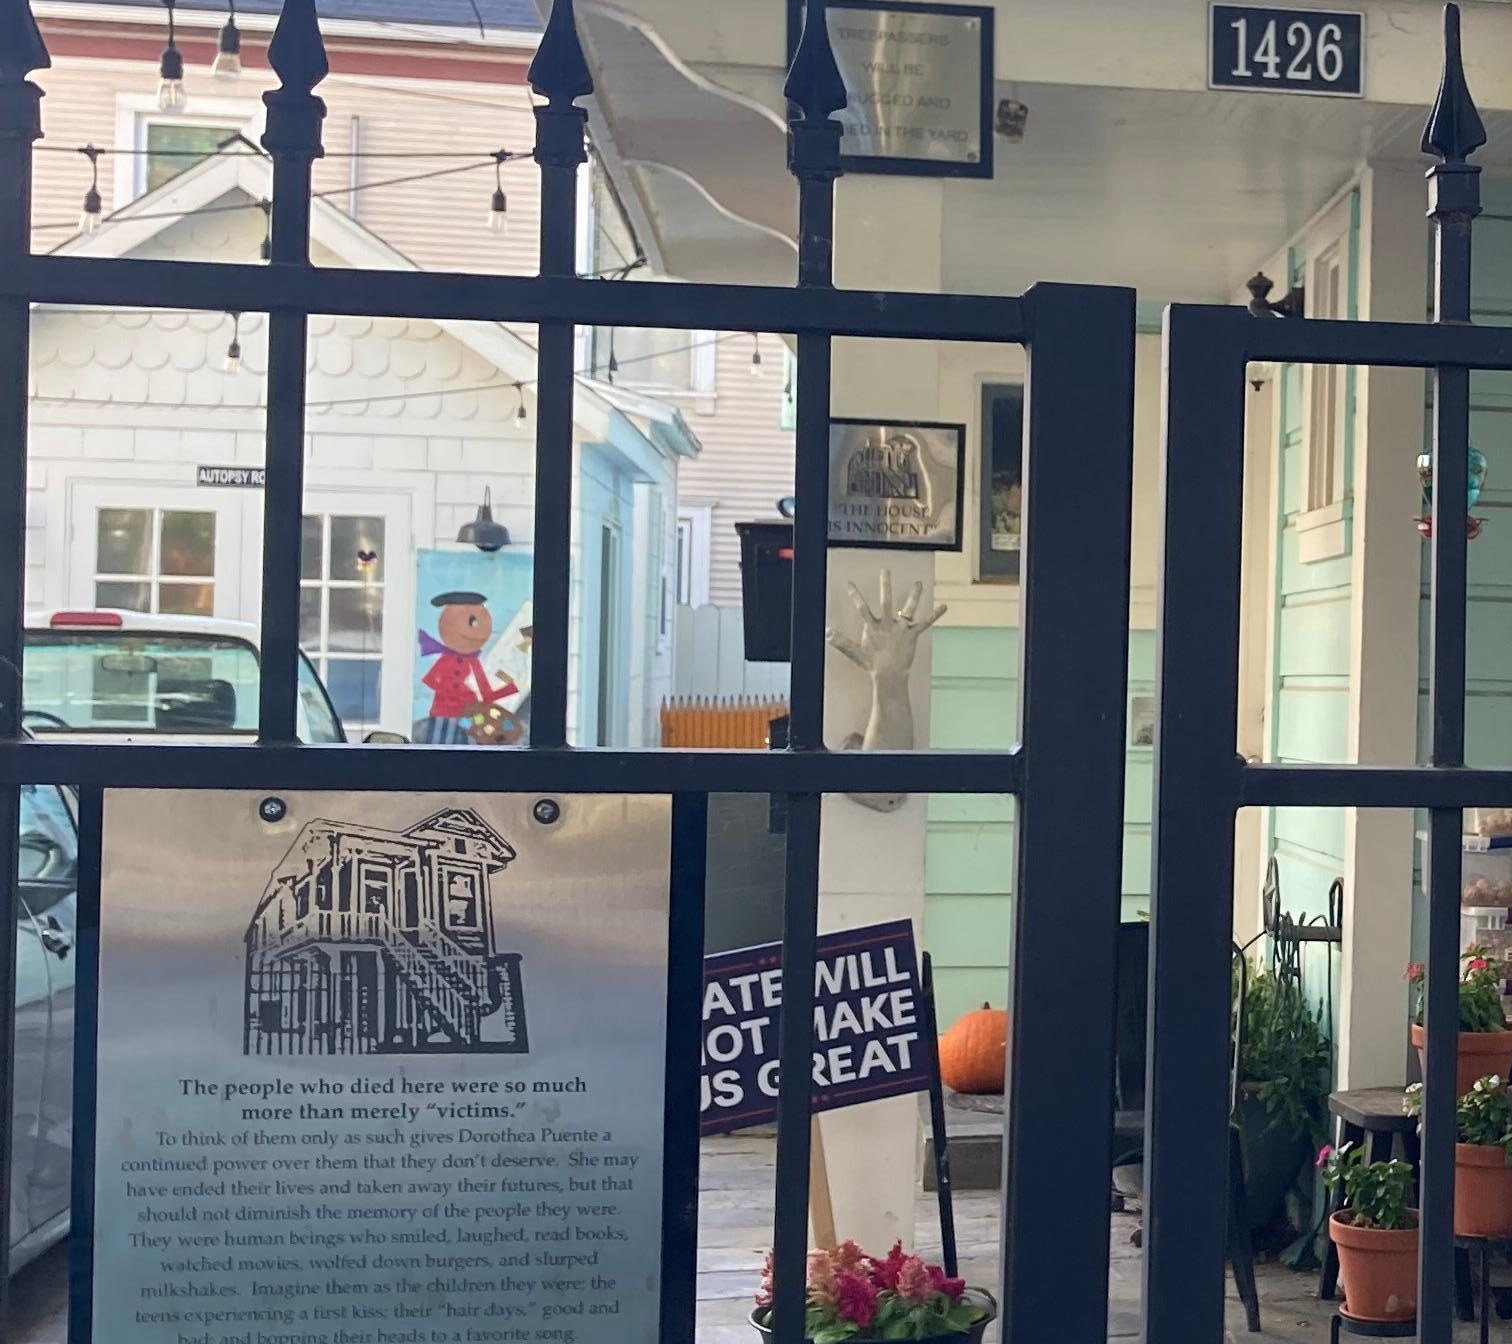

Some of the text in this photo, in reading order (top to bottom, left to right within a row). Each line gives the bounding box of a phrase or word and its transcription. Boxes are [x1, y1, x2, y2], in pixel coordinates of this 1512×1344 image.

[838, 28, 950, 46] TRESPASSERS
[1231, 18, 1343, 82] 1426
[862, 62, 924, 76] WILL BE
[918, 96, 951, 109] AND
[895, 126, 925, 140] THE
[928, 128, 969, 142] YARD
[200, 467, 265, 484] AUTOPSY RO
[877, 504, 930, 518] HOUSE
[702, 968, 782, 1021] ATE
[702, 1017, 770, 1066] OT
[178, 1075, 587, 1102] The people who died here were so much
[241, 1100, 527, 1126] more than merely "victims."
[155, 1126, 612, 1151] To think of them only as such gives Dorothea Puente a
[120, 1151, 639, 1177] continued power over them that they don't deserve. She may
[126, 1176, 633, 1200] have ended their lives and taken away their futures, but that
[137, 1205, 197, 1222] should
[202, 1207, 230, 1221] not
[235, 1204, 311, 1221] diminish
[315, 1203, 342, 1220] the
[346, 1207, 417, 1225] memory
[421, 1202, 441, 1218] of
[444, 1202, 471, 1218] the
[474, 1201, 531, 1224] people
[535, 1200, 571, 1223] they
[128, 1225, 629, 1253] They were human beings who smiled, laughed, read books,
[160, 1255, 233, 1272] watched
[308, 1253, 367, 1270] wolfed
[372, 1253, 421, 1269] down
[497, 1251, 530, 1268] and
[251, 1279, 321, 1302] Imagine
[325, 1278, 369, 1295] them
[373, 1282, 392, 1294] as
[395, 1277, 422, 1294] the
[425, 1276, 497, 1293] children
[500, 1276, 537, 1298] they
[591, 1274, 617, 1291] the
[135, 1308, 181, 1323] teens
[183, 1306, 295, 1328] experiencing
[298, 1308, 309, 1320] a
[312, 1303, 348, 1320] first
[393, 1302, 433, 1318] their
[541, 1299, 584, 1322] good
[588, 1298, 620, 1315] and
[333, 1328, 373, 1344] their
[377, 1327, 426, 1344] heads
[430, 1329, 447, 1343] to
[451, 1332, 462, 1343] a
[466, 1326, 531, 1343] favorite
